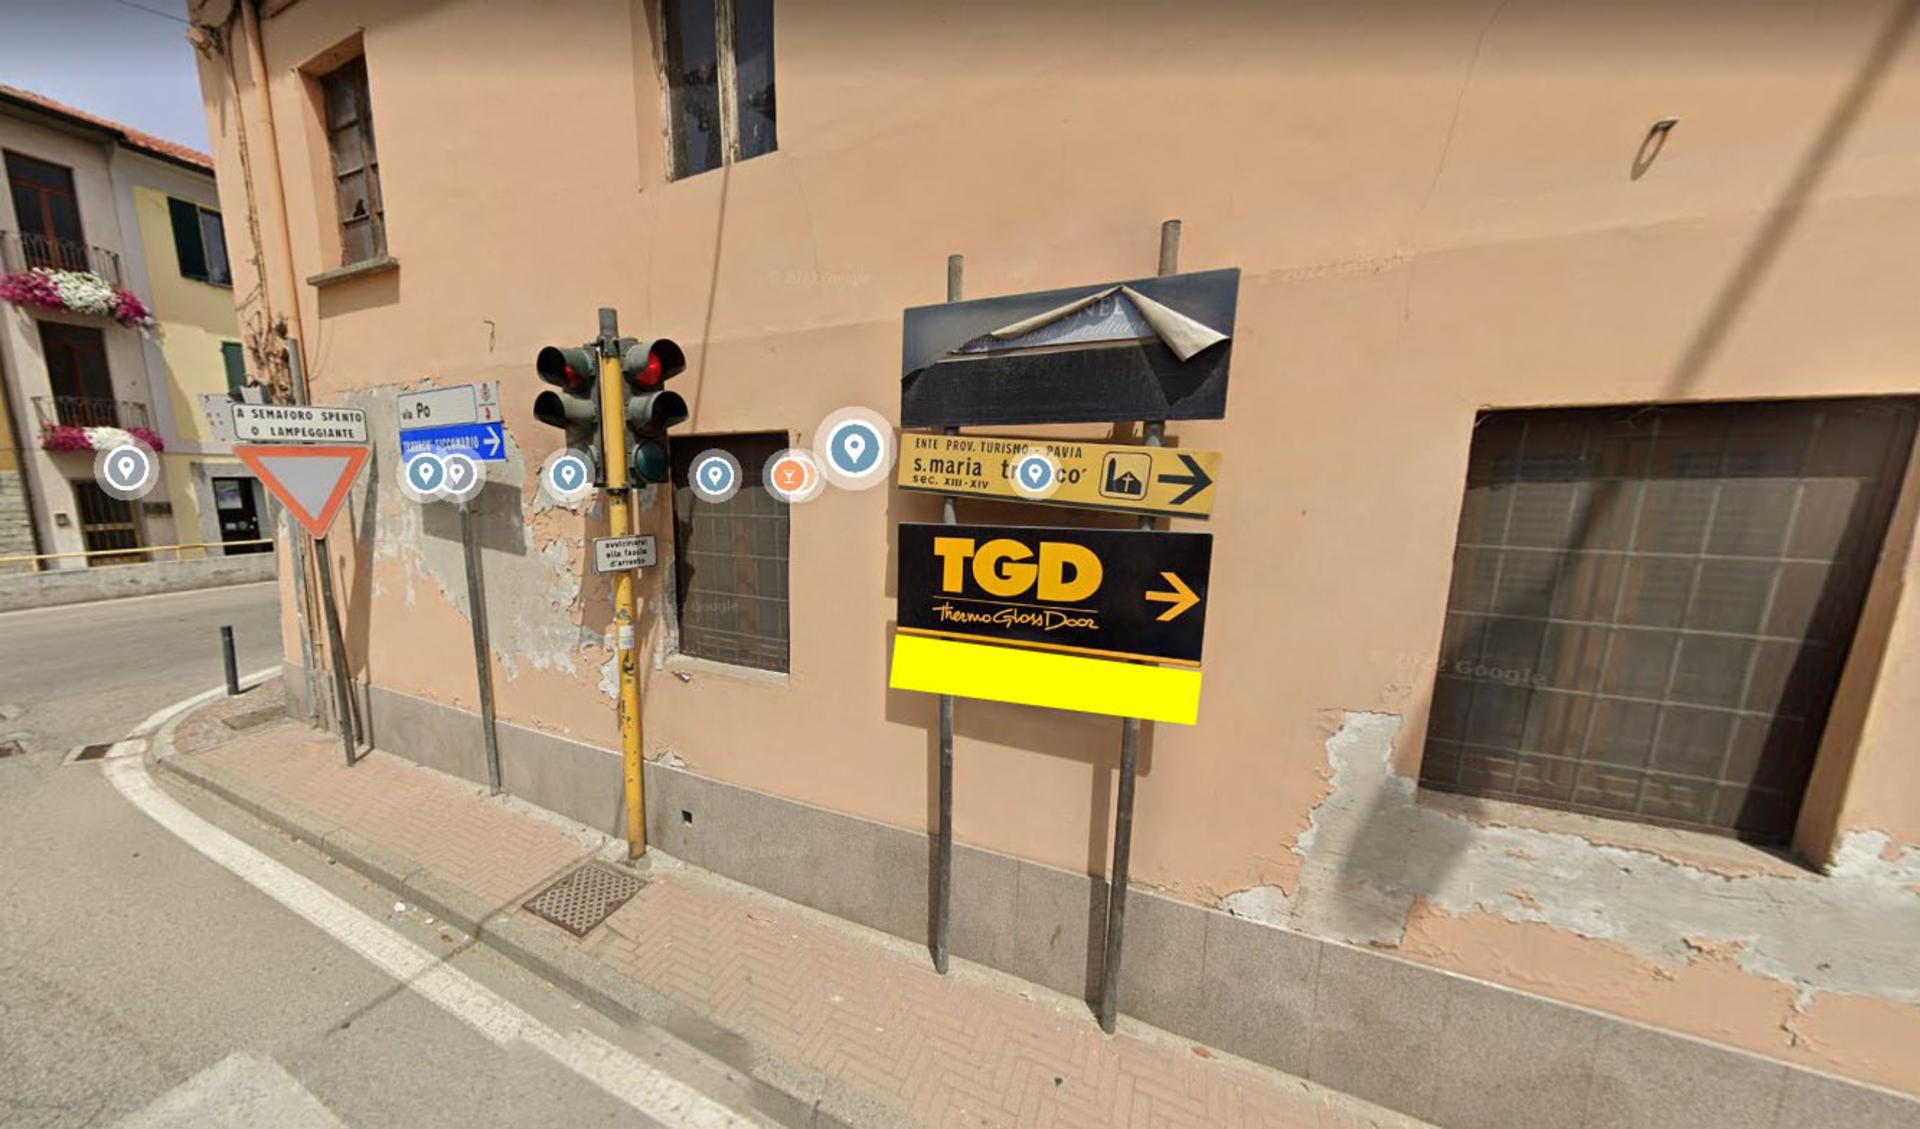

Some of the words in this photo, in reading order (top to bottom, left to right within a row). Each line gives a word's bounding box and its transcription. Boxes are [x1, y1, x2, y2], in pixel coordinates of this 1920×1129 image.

[237, 409, 245, 418] A
[251, 409, 314, 421] SEMAFORO
[321, 411, 362, 422] SPENTO
[416, 402, 431, 418] Po
[251, 426, 259, 436] O
[270, 427, 355, 438] LAMPEGGIANTE
[915, 438, 939, 449] ENTE
[946, 439, 976, 452] PROV.
[980, 441, 1029, 455] TURISMO
[1047, 444, 1083, 459] PAVIA
[913, 456, 982, 477] s.maria
[912, 474, 938, 485] sec.
[933, 536, 1104, 602] TGD
